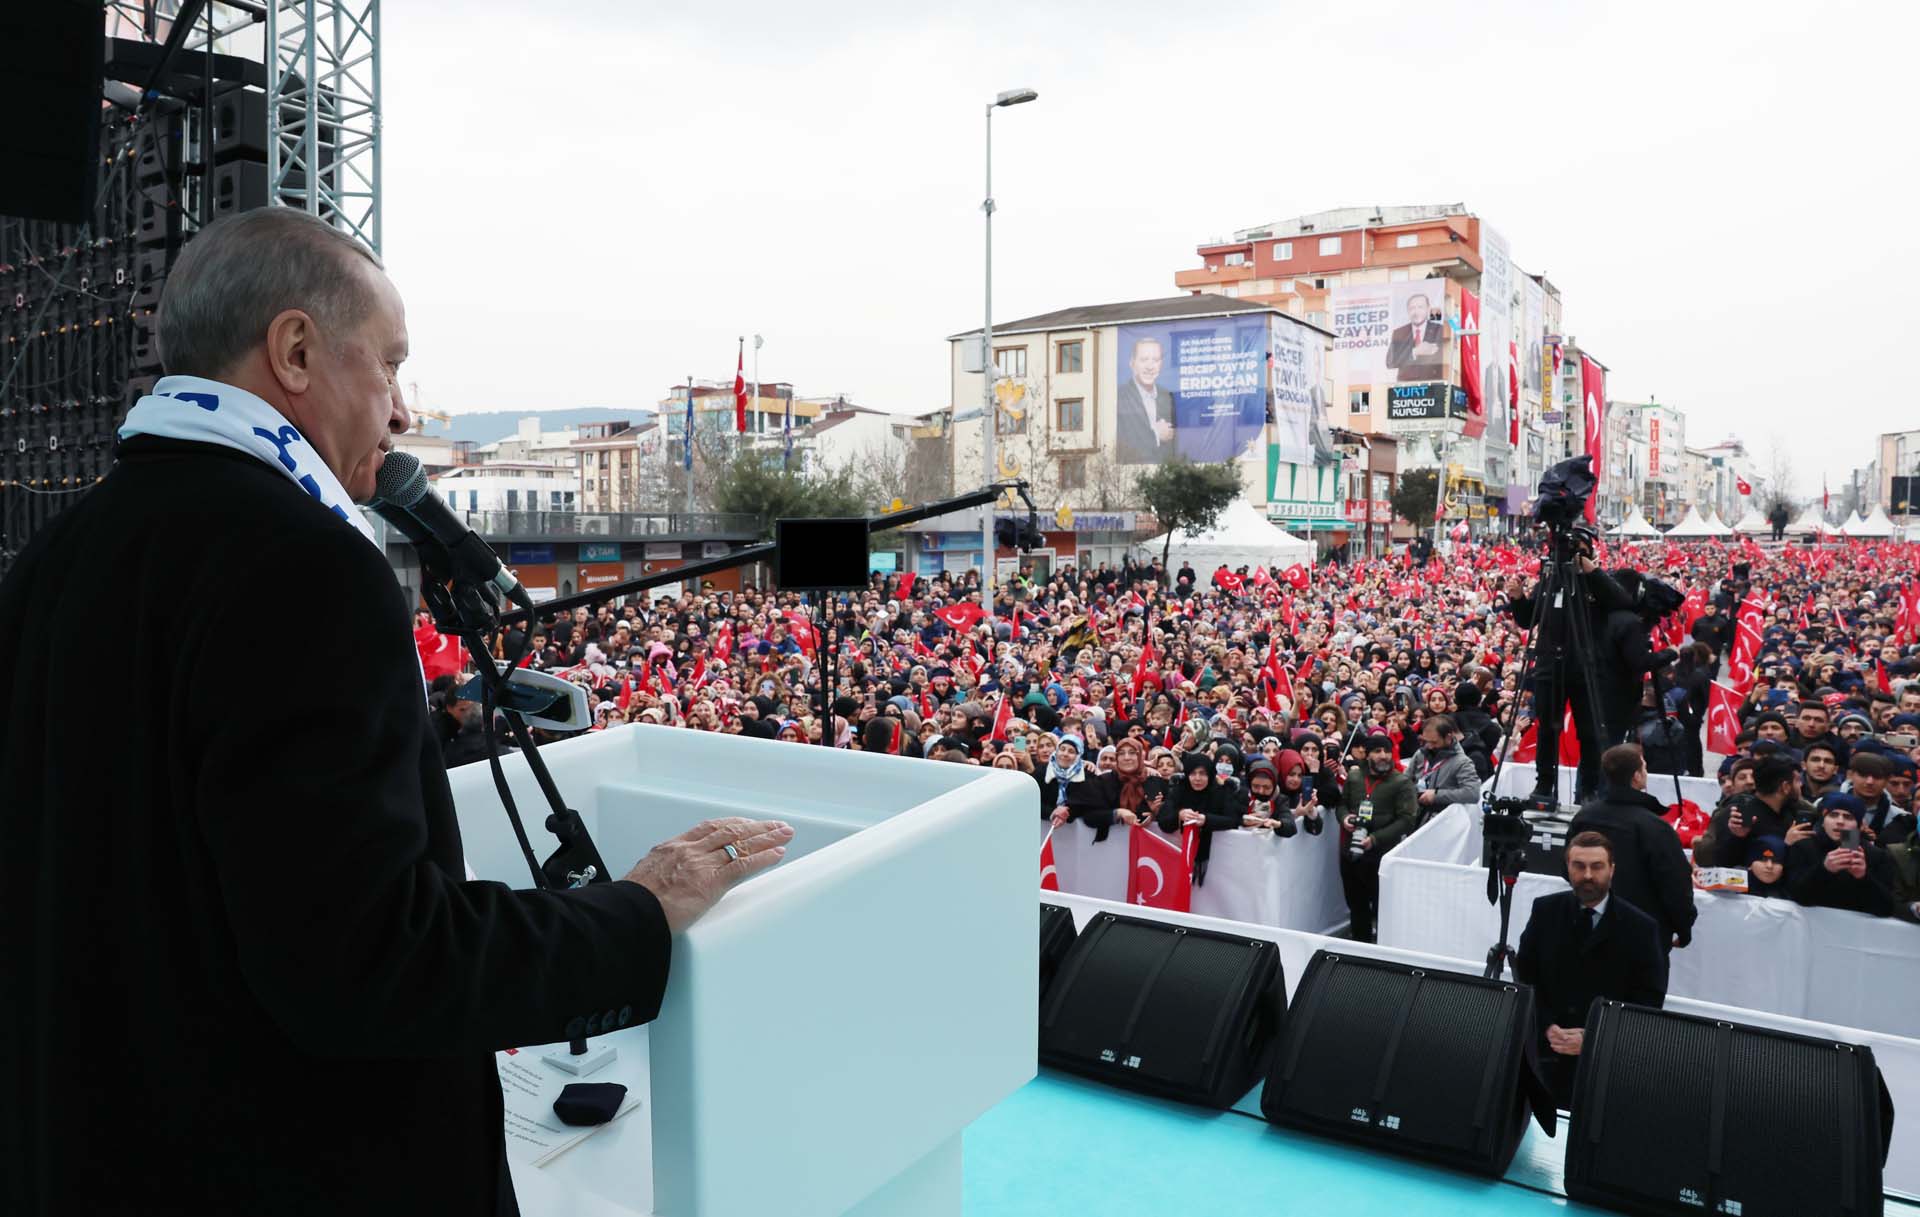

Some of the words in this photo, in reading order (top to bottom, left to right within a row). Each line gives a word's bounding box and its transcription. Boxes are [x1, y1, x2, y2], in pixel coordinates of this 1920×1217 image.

[1335, 310, 1389, 326] RECEP
[1180, 364, 1216, 375] RECEP
[1180, 372, 1258, 391] ERDOĞAN
[1393, 386, 1428, 397] YURT
[1392, 408, 1427, 417] KURSU
[1680, 1187, 1698, 1199] d&b
